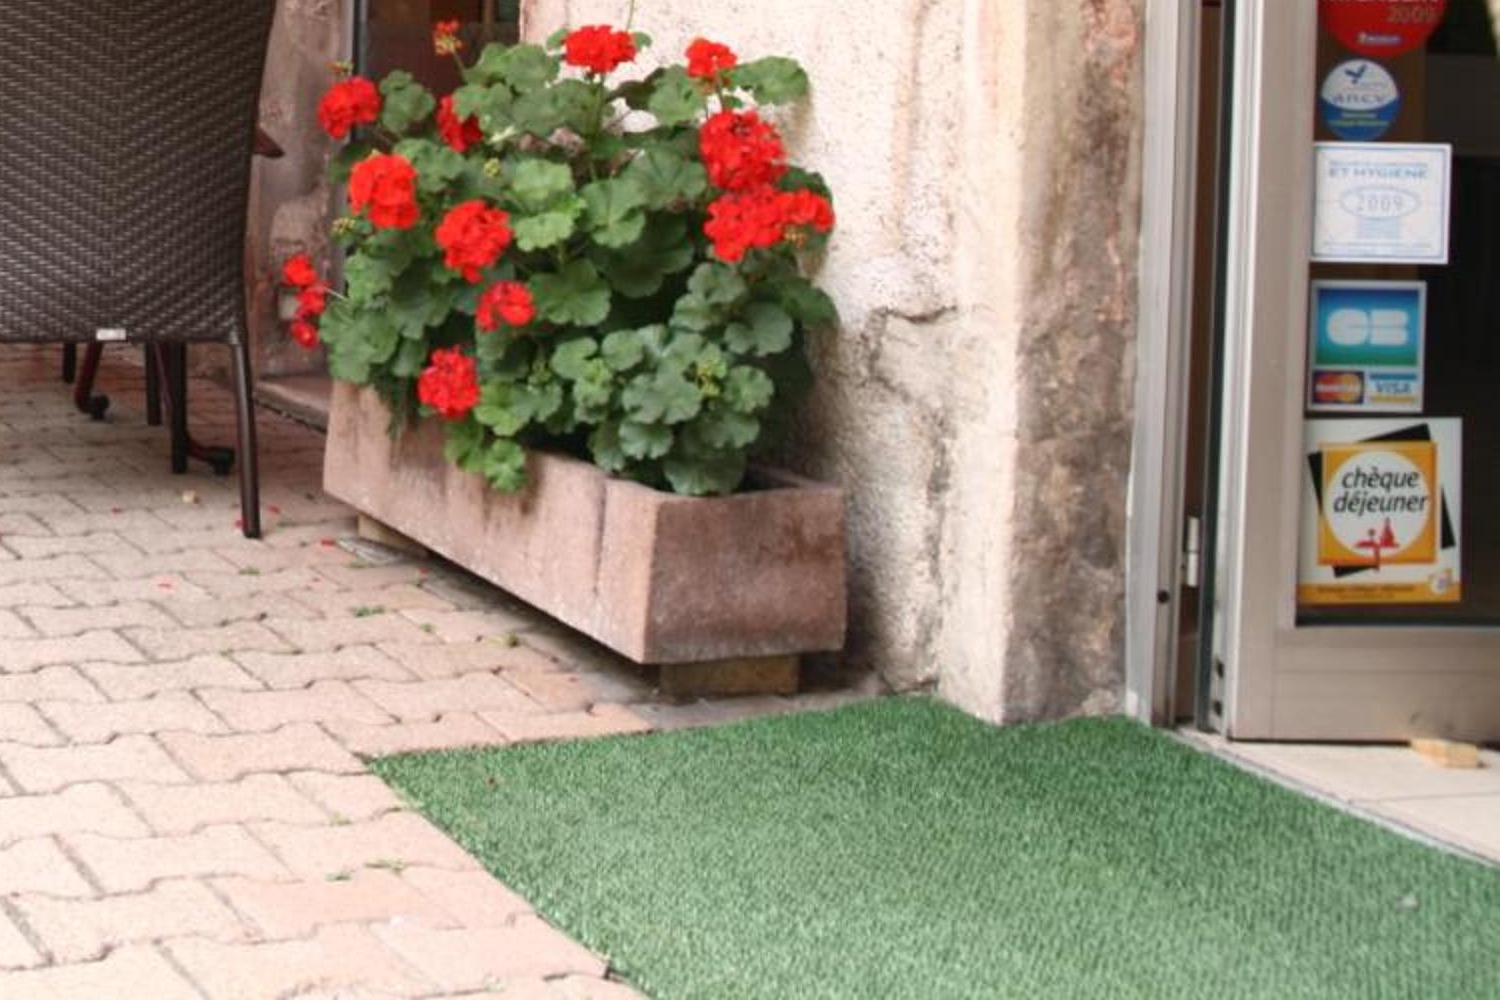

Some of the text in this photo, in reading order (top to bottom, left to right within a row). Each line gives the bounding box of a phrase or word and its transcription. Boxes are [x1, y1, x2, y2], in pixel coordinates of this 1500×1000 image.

[1374, 381, 1413, 394] VISA
[1341, 466, 1420, 492] chèque
[1333, 491, 1429, 516] déjeuner
